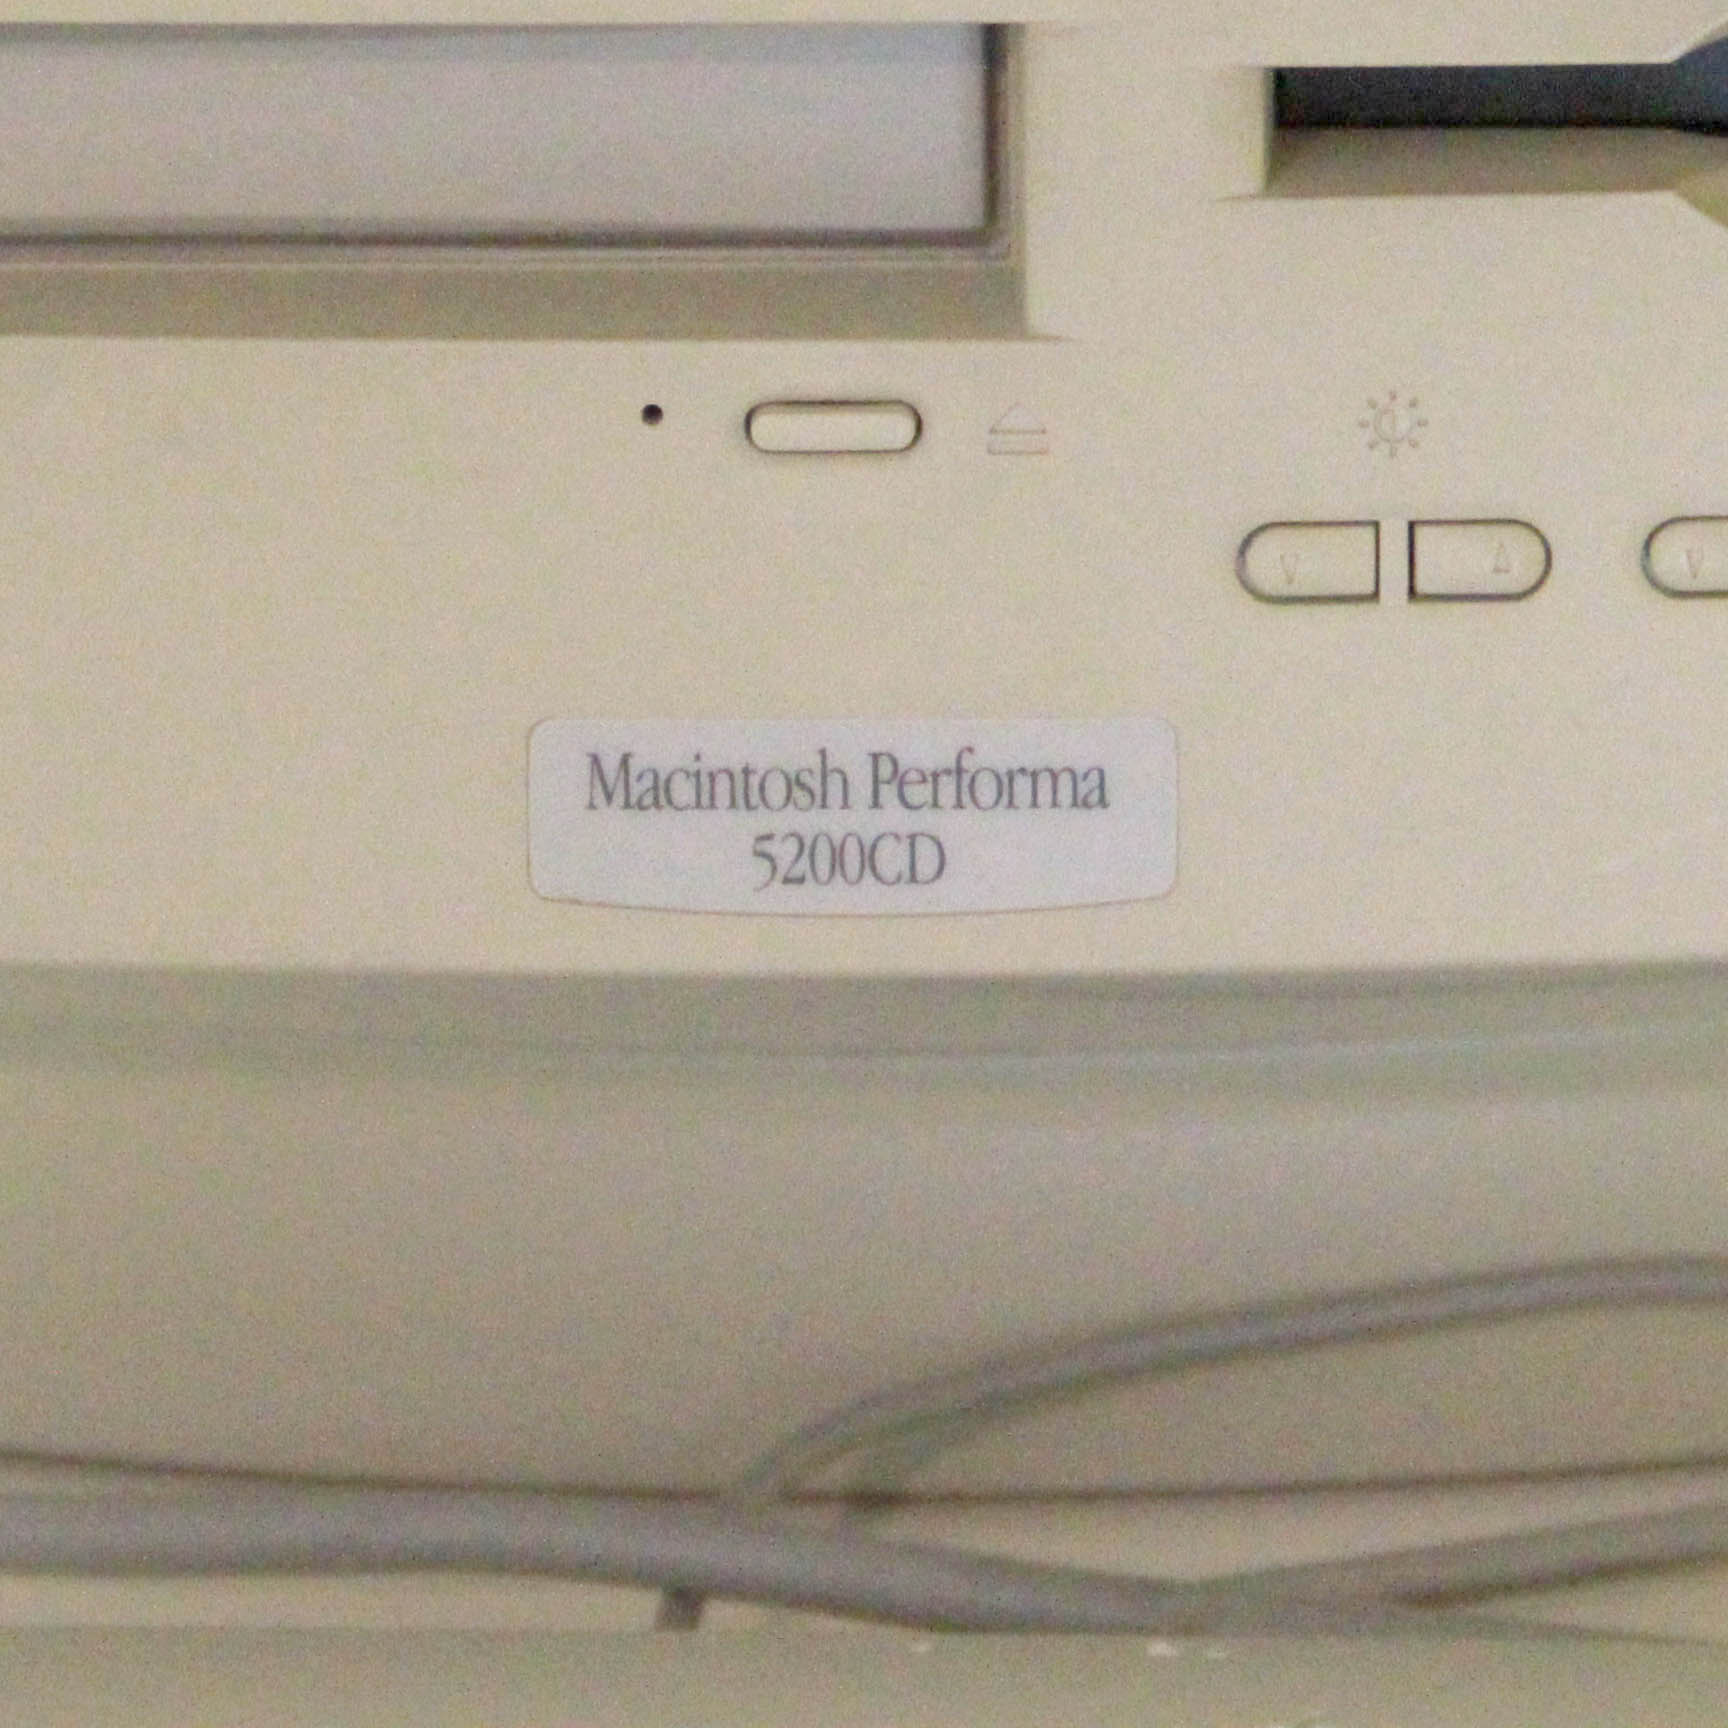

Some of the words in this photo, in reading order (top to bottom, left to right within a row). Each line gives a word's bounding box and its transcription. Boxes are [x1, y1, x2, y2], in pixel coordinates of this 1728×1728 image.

[585, 747, 851, 814] Macintosh
[868, 746, 1111, 813] Performa
[750, 830, 948, 892] 5200CD
